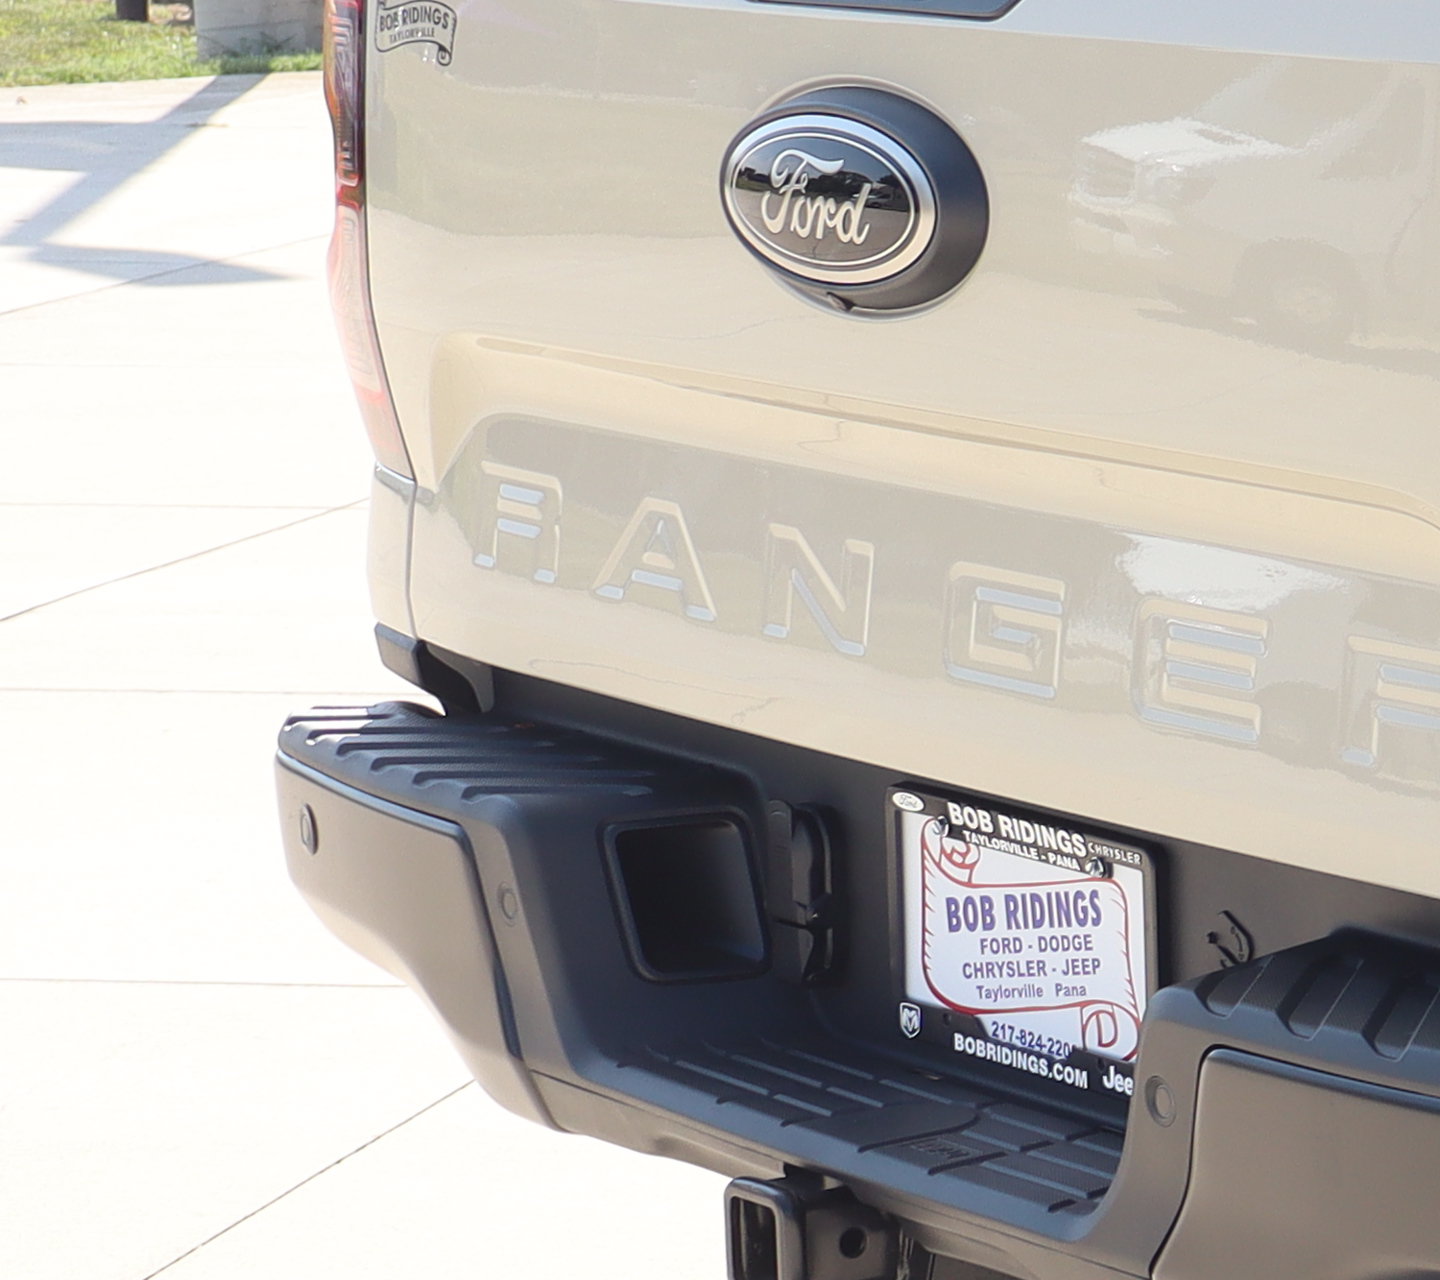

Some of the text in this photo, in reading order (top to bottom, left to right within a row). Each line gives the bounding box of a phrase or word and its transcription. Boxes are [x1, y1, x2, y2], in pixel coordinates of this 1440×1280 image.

[402, 6, 449, 30] RIDINGS
[761, 149, 870, 244] Ford
[947, 802, 1087, 857] BOB RIDINGS
[962, 830, 1039, 860] TAYLORVILLE
[1049, 852, 1081, 871] PANA
[1087, 841, 1142, 865] CHRYSLER
[945, 889, 1102, 933] BOB RIDINGS
[980, 937, 1023, 955] FORD
[1037, 934, 1093, 953] DODGE
[962, 960, 1047, 979] CHRYSLER
[1062, 958, 1101, 976] JEEP
[976, 983, 1087, 1002] Taylorville Pana
[991, 1021, 1075, 1059] 217-824-220
[954, 1033, 1088, 1089] BOBRIDINGS.COM
[1103, 1066, 1134, 1096] Jee
